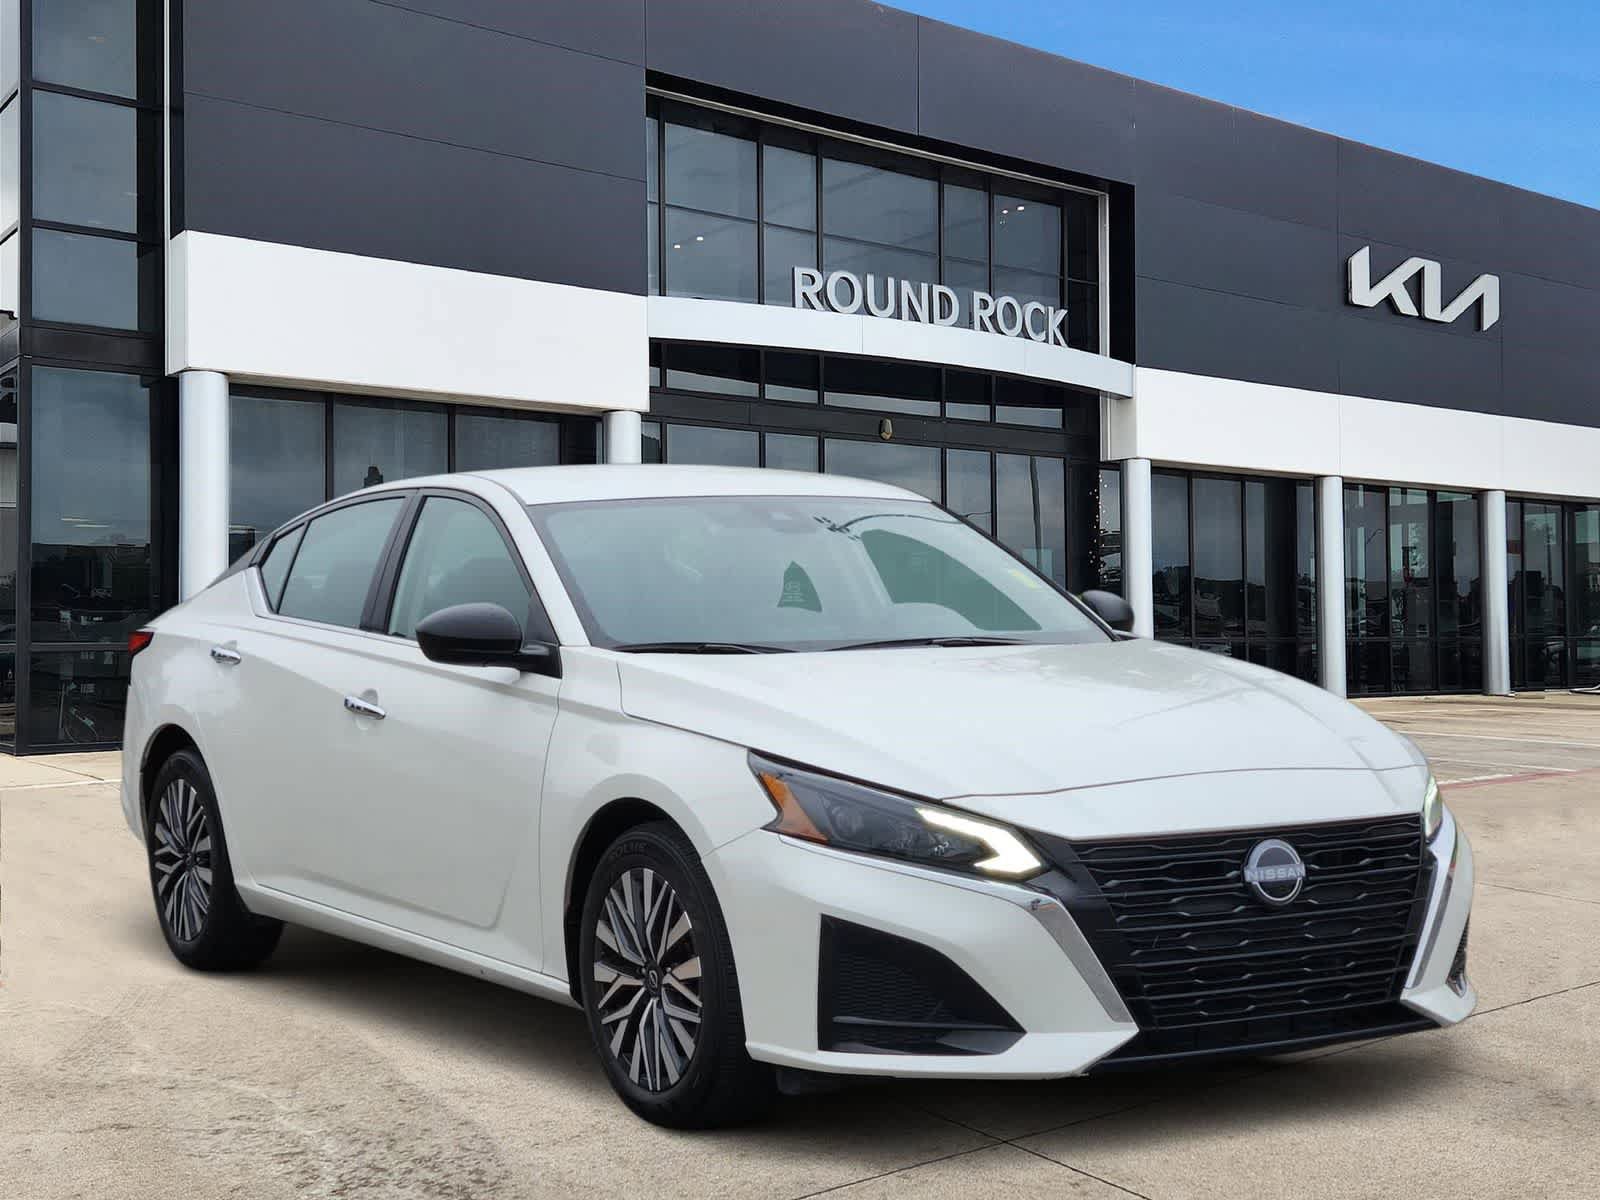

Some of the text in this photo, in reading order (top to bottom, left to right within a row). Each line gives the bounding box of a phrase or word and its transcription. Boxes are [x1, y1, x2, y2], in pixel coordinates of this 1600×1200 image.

[793, 266, 1069, 348] ROUND ROCK
[1247, 866, 1304, 882] NISSAN
